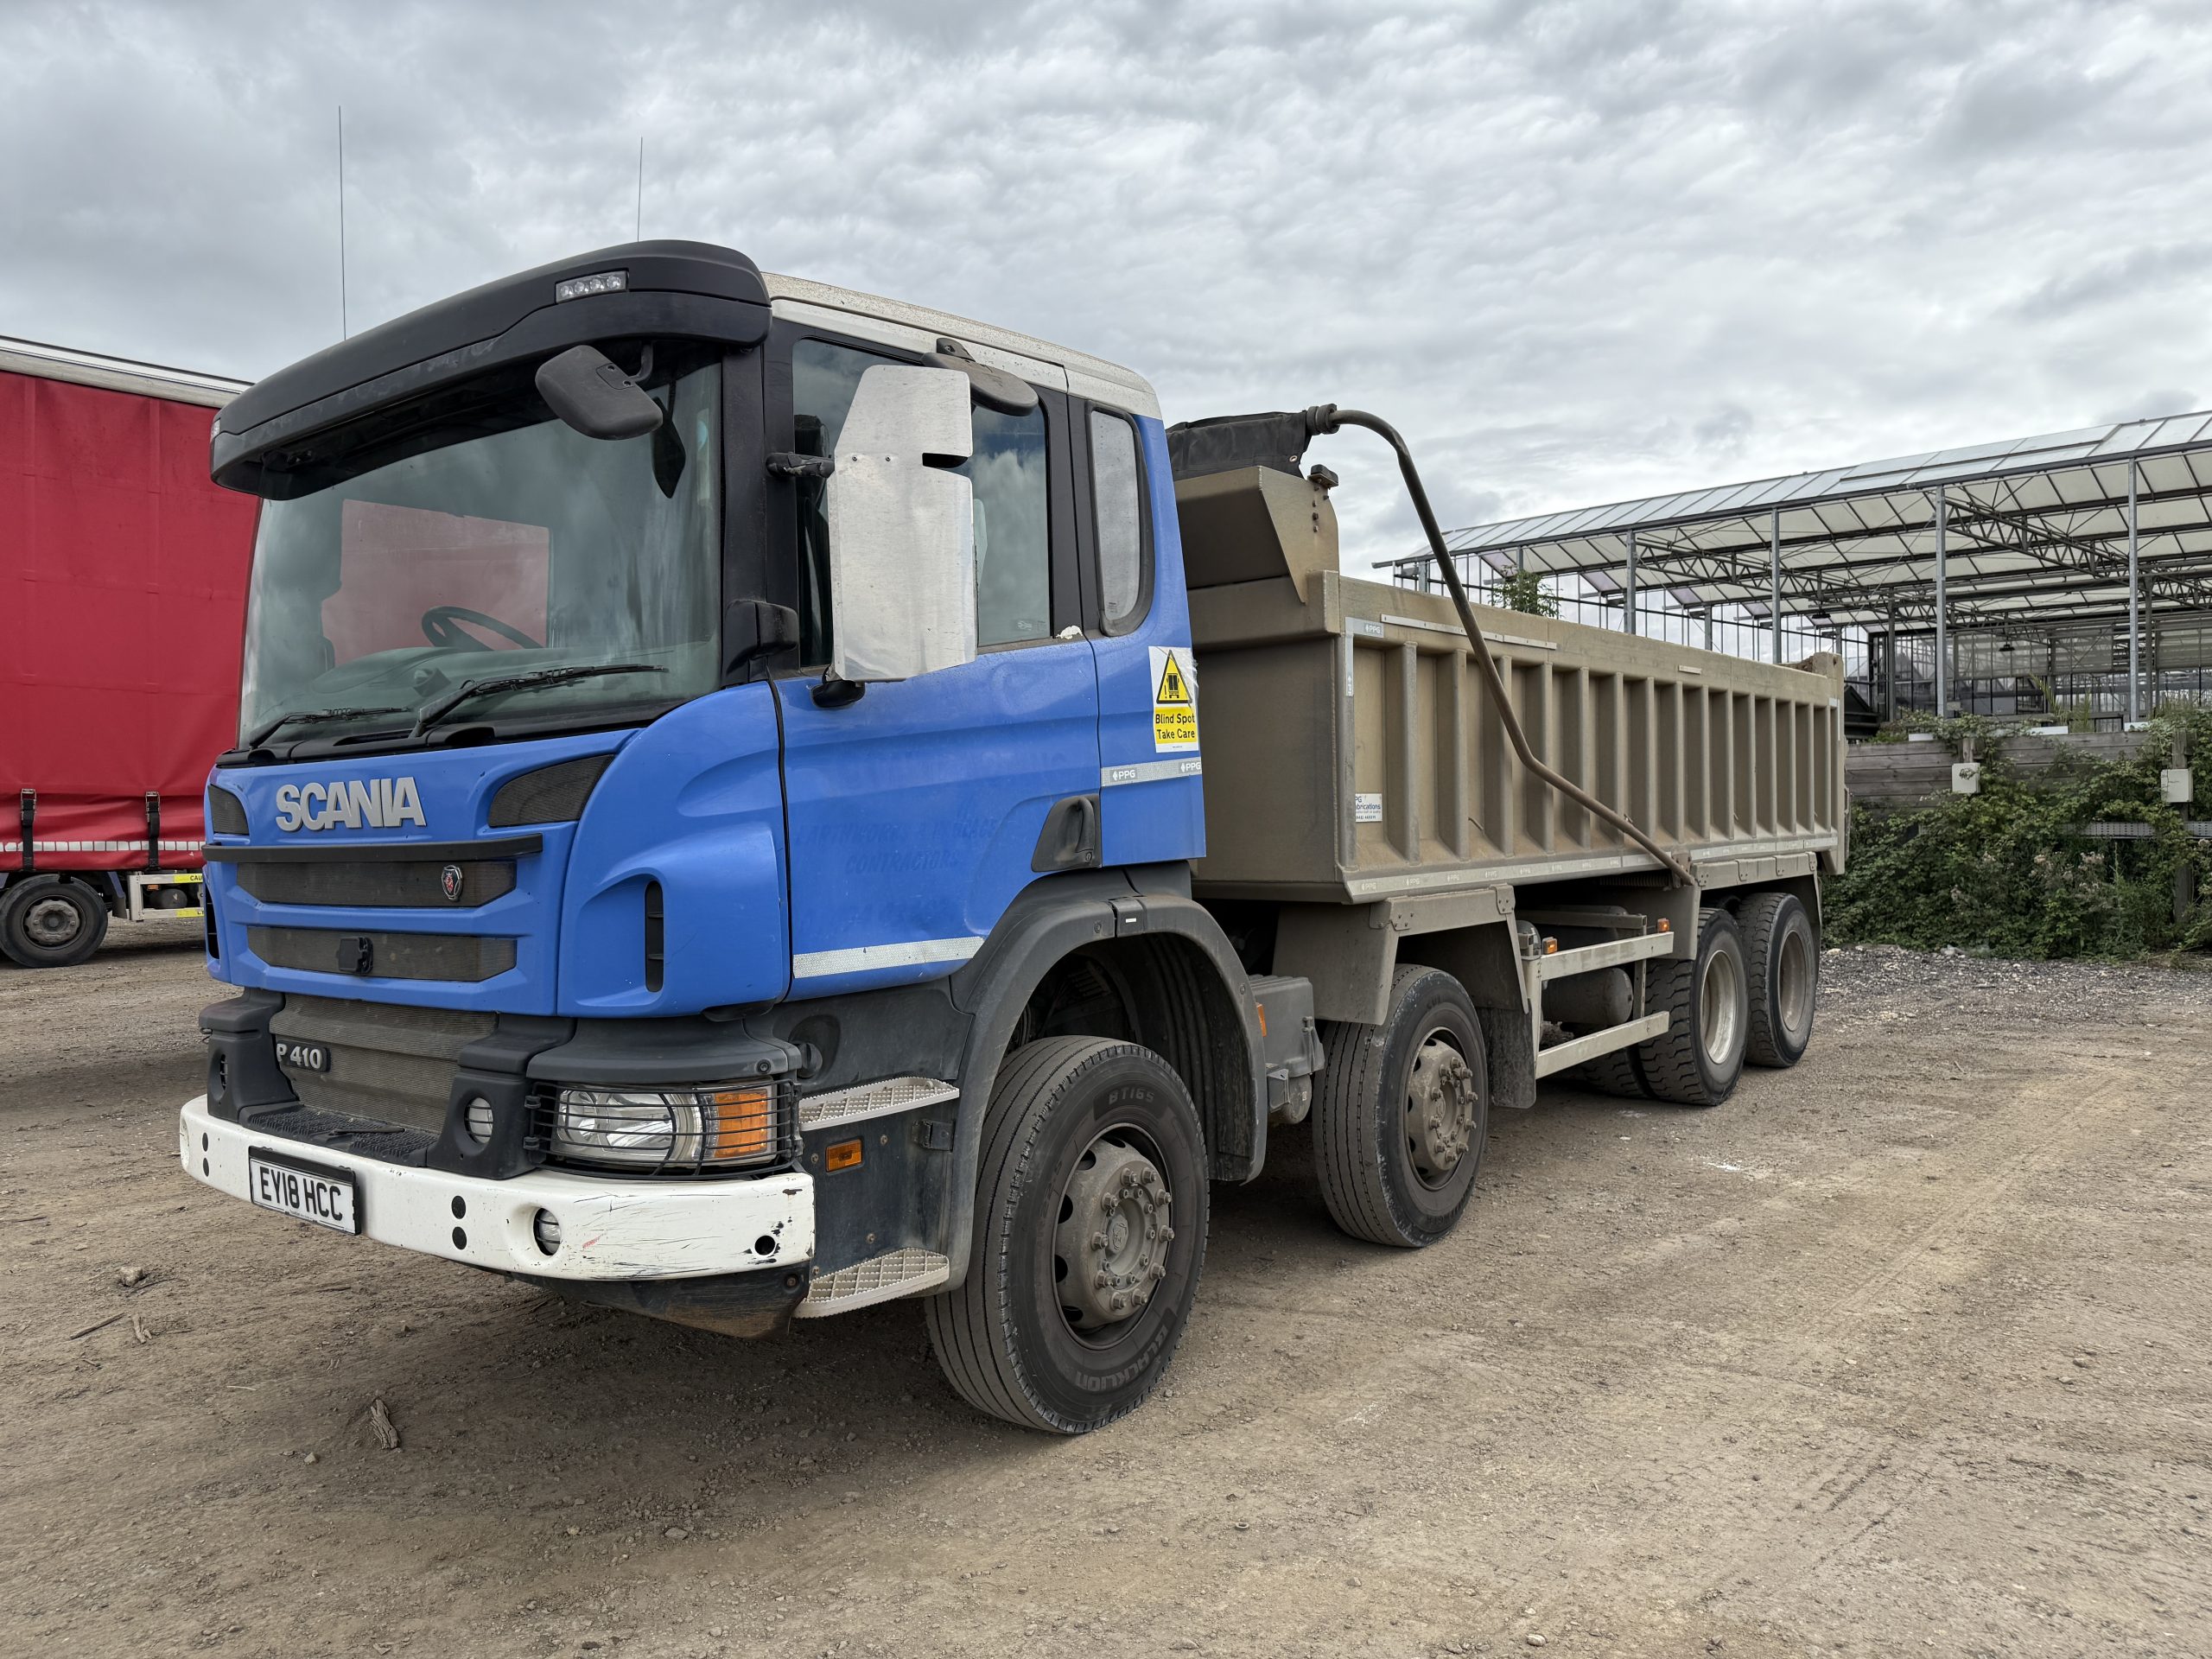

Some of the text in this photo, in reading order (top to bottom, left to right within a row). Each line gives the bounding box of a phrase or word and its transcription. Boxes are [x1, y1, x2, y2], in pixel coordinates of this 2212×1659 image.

[1369, 625, 1381, 634] PPG
[1155, 713, 1195, 725] Blind Spot
[1156, 728, 1195, 740] Take Care
[1118, 761, 1202, 780] PPG PPG
[276, 777, 427, 832] SCANIA
[276, 1043, 322, 1069] P 410
[259, 1166, 343, 1221] EY18 HCC
[1074, 1325, 1168, 1392] BLACKLION
